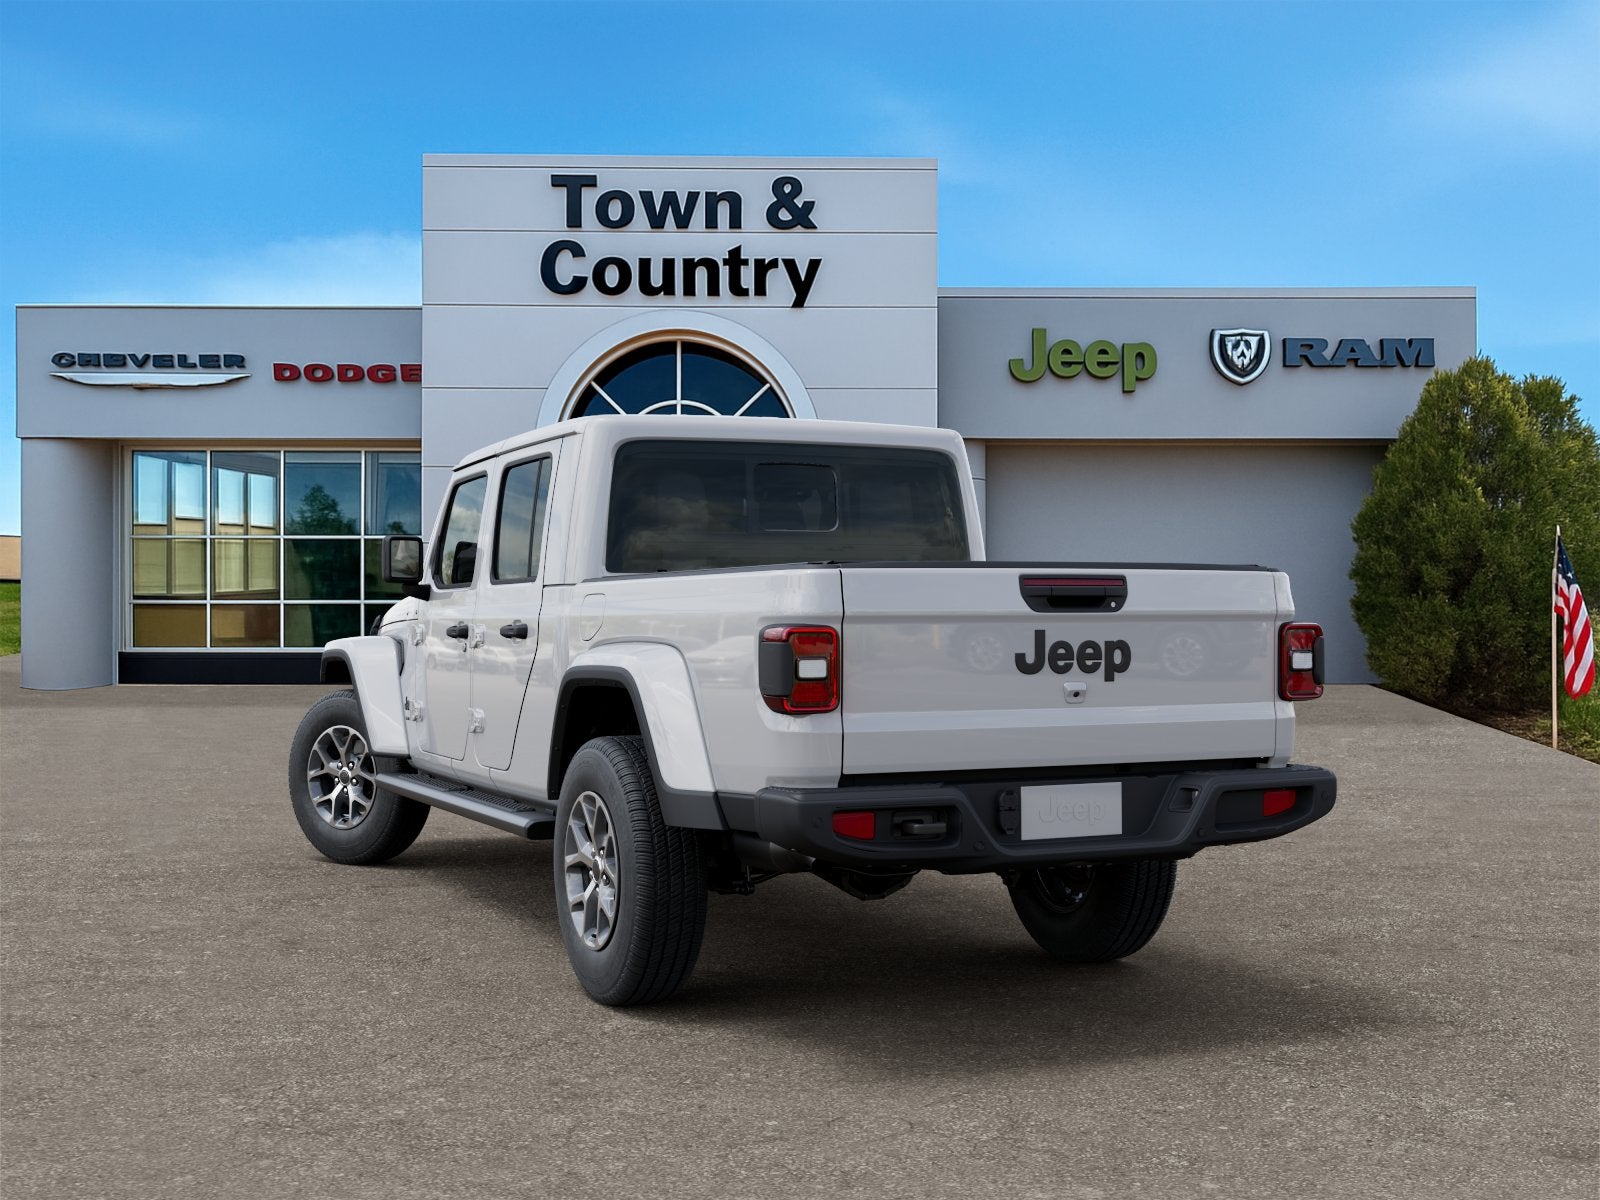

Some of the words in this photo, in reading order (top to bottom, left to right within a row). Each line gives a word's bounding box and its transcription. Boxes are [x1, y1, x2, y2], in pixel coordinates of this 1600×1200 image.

[550, 174, 743, 230] Town
[765, 175, 818, 230] &
[540, 239, 823, 308] Country
[272, 362, 422, 384] DODGE
[1009, 327, 1157, 393] Jeep
[1282, 337, 1435, 367] RAM
[1015, 629, 1132, 682] Jeep
[1038, 790, 1105, 826] Jeep
